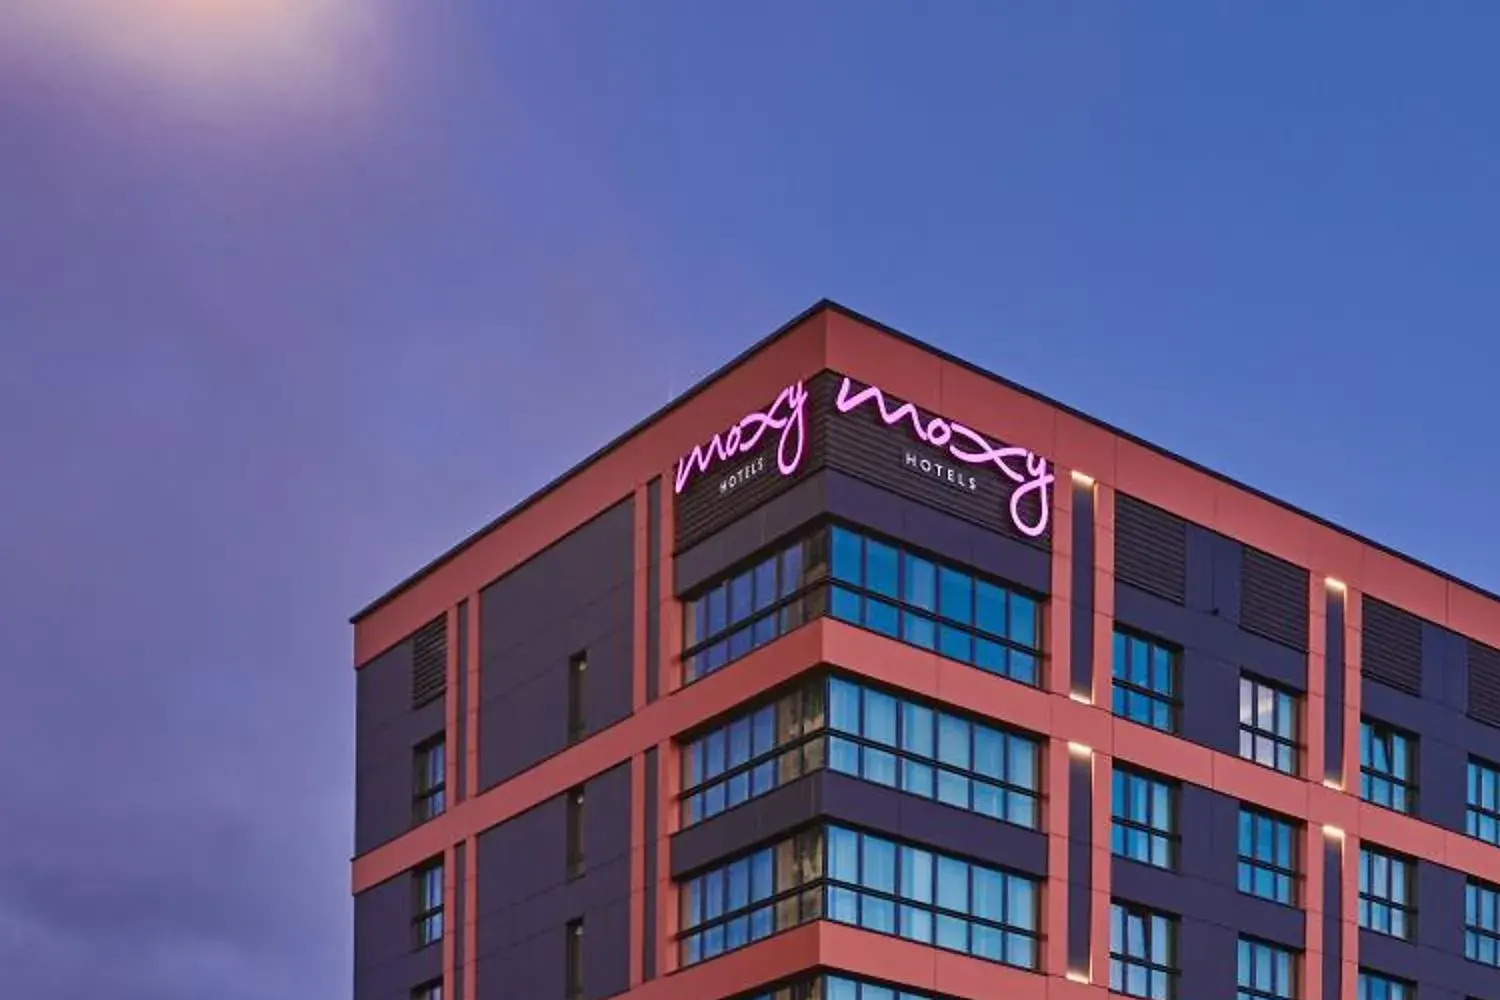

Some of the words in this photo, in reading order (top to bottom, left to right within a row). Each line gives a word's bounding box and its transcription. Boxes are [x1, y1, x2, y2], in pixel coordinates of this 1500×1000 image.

[675, 379, 808, 494] moxy
[719, 457, 763, 493] HOTELS
[836, 377, 1055, 537] moxy
[905, 452, 977, 491] HOTELS
